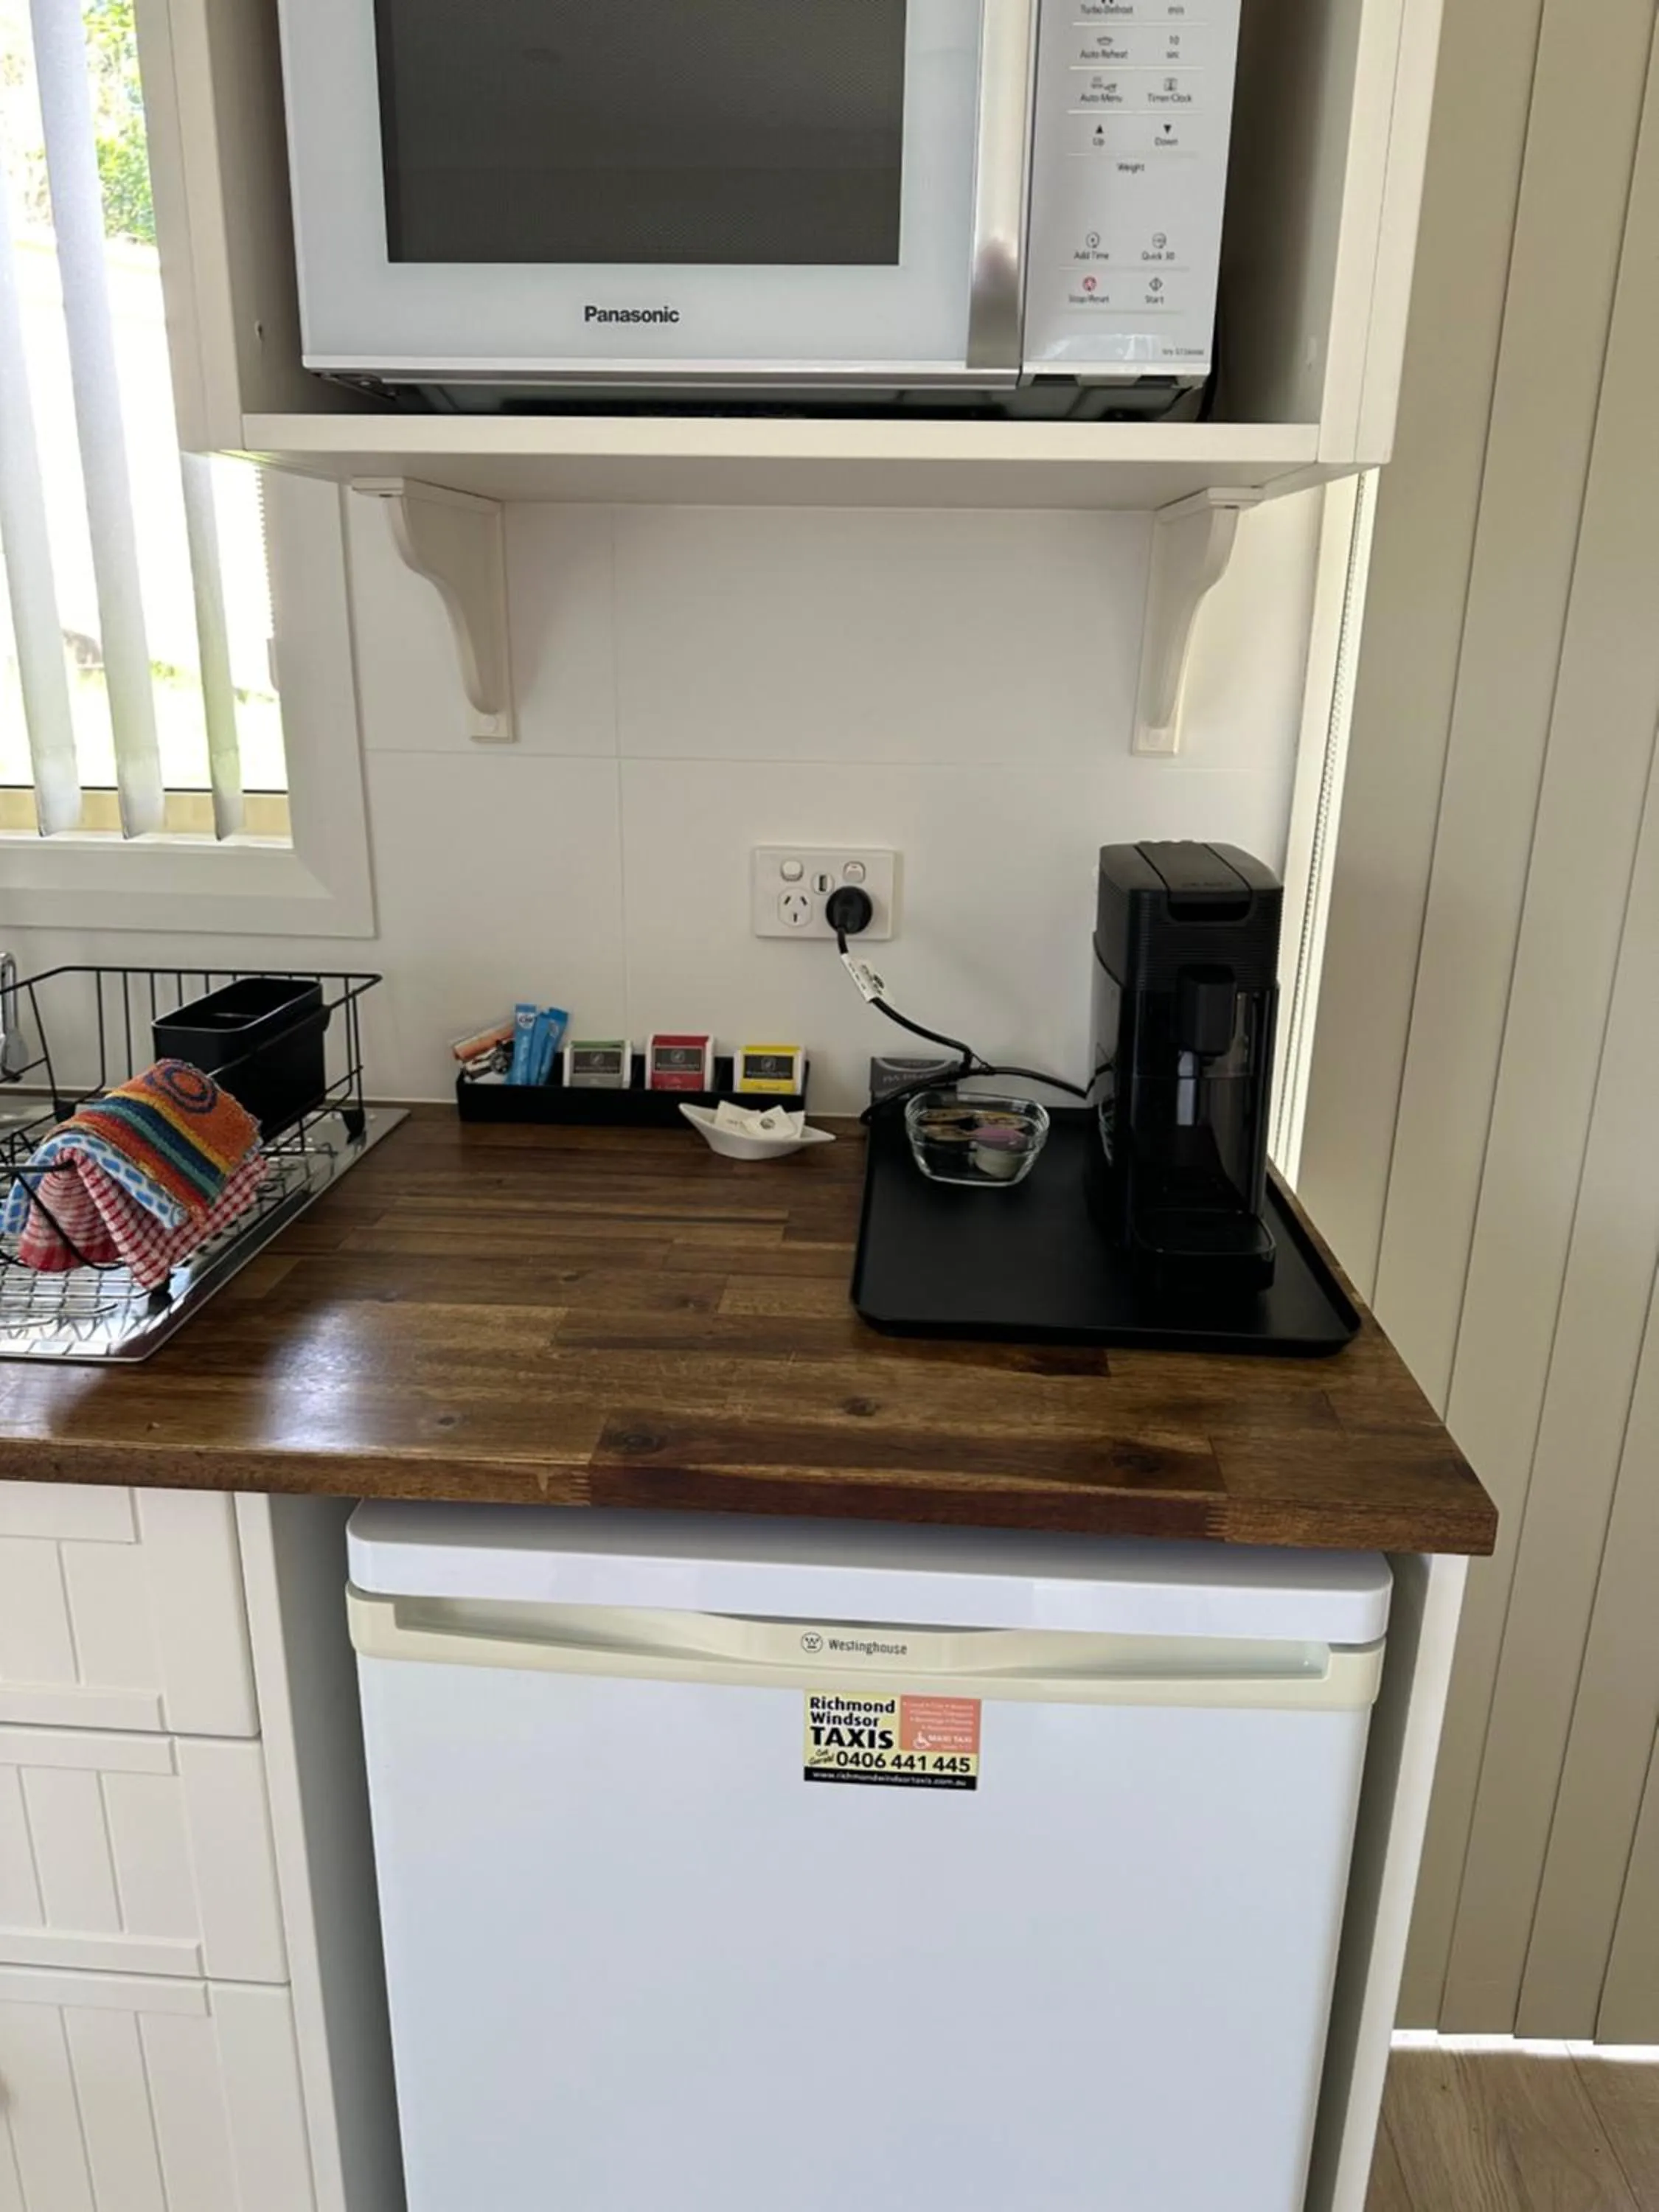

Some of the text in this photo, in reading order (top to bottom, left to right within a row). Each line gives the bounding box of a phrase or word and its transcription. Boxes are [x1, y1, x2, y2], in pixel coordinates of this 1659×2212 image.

[1080, 4, 1133, 14] Turbo Defrost
[1080, 49, 1128, 59] Auto Reheat
[1080, 94, 1122, 102] Auto Menu
[1093, 138, 1105, 147] Up
[1155, 138, 1178, 146] Down
[1117, 163, 1145, 173] Weight
[1074, 251, 1109, 260] Add Time
[1141, 251, 1162, 260] Quick
[1145, 295, 1164, 304] Start
[584, 305, 680, 323] Panasonic
[829, 1638, 907, 1655] Westinghouse
[810, 1696, 895, 1714] Richmond
[810, 1711, 880, 1727] Windsor
[810, 1726, 894, 1750] TAXIS
[836, 1750, 970, 1773] 0406 441 445
